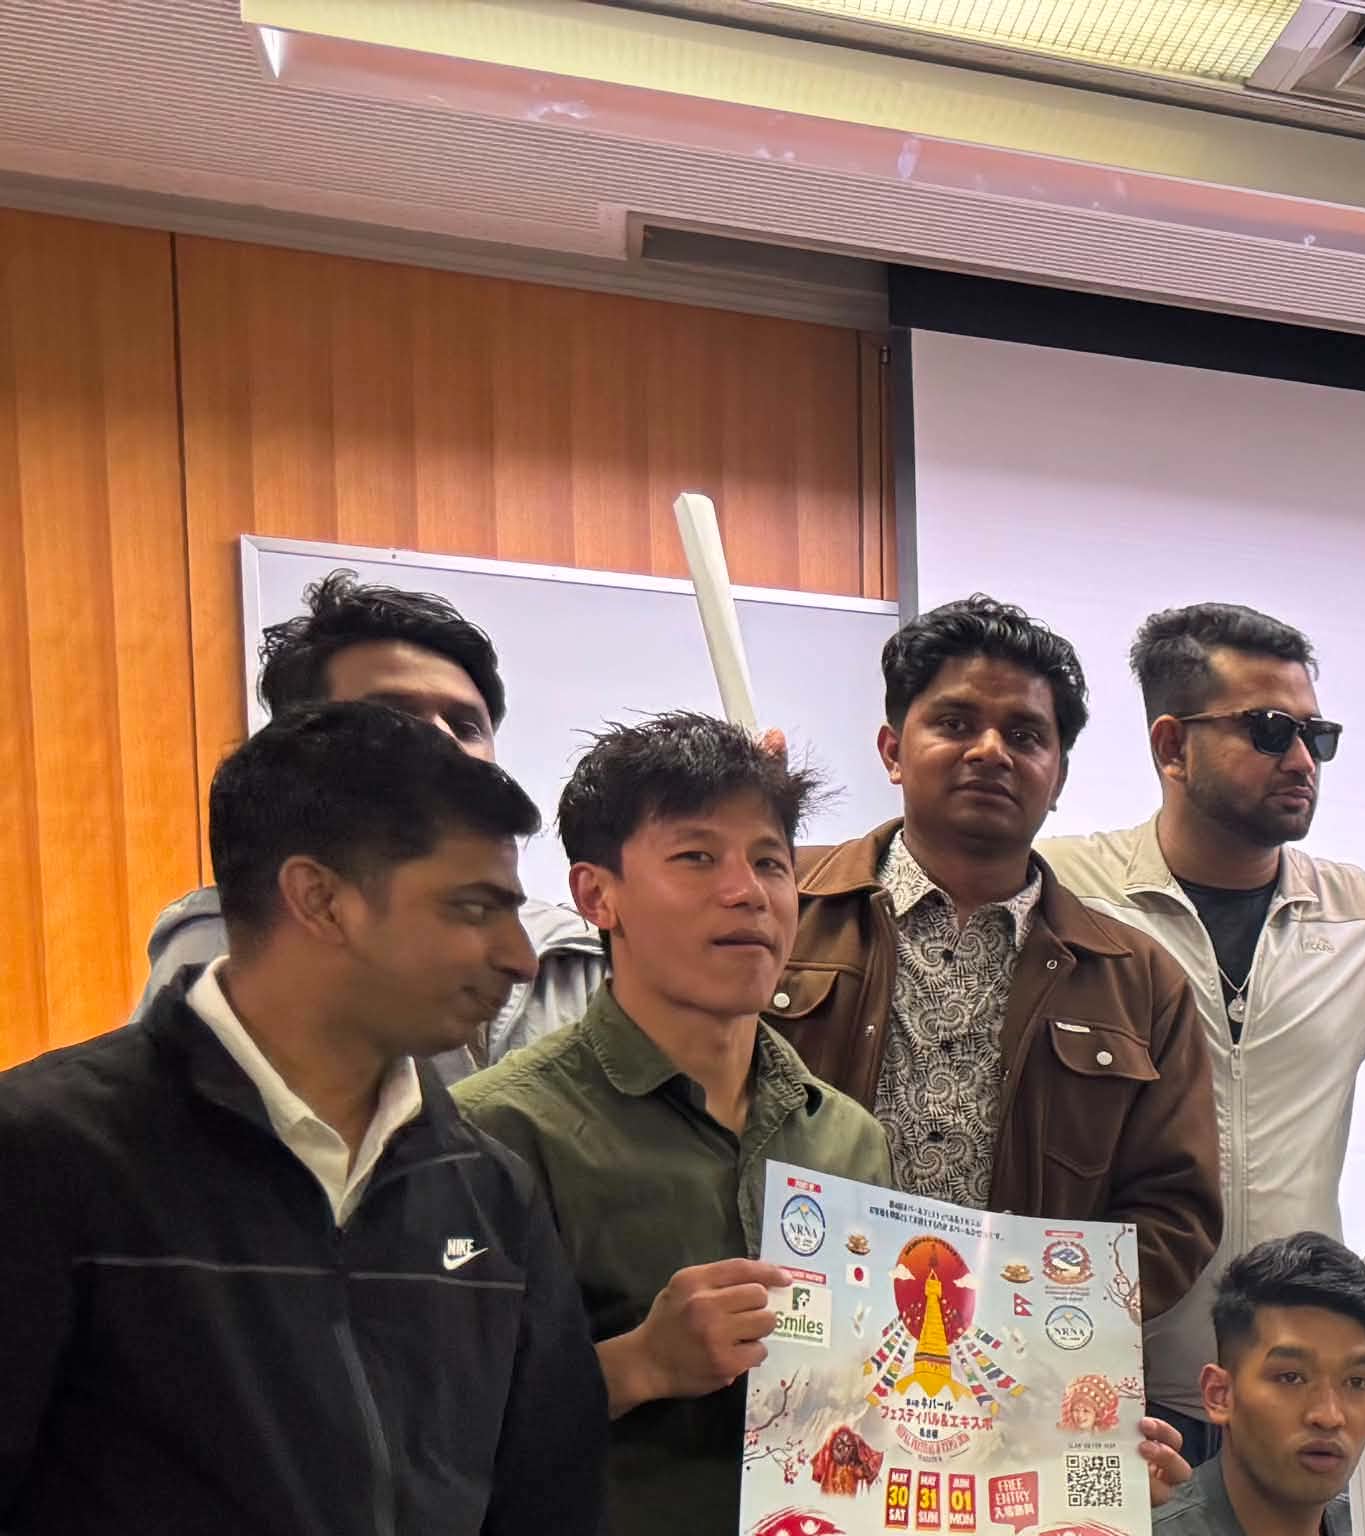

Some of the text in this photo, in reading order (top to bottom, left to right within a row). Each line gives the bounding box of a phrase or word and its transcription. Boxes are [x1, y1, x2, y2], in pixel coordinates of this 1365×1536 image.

[447, 1238, 474, 1257] NIKE
[775, 1311, 824, 1335] Smiles
[998, 1478, 1024, 1491] FREE
[889, 1487, 908, 1505] 30
[920, 1489, 937, 1508] 31
[951, 1491, 972, 1511] 01
[889, 1508, 906, 1521] SAT
[950, 1512, 975, 1525] MON
